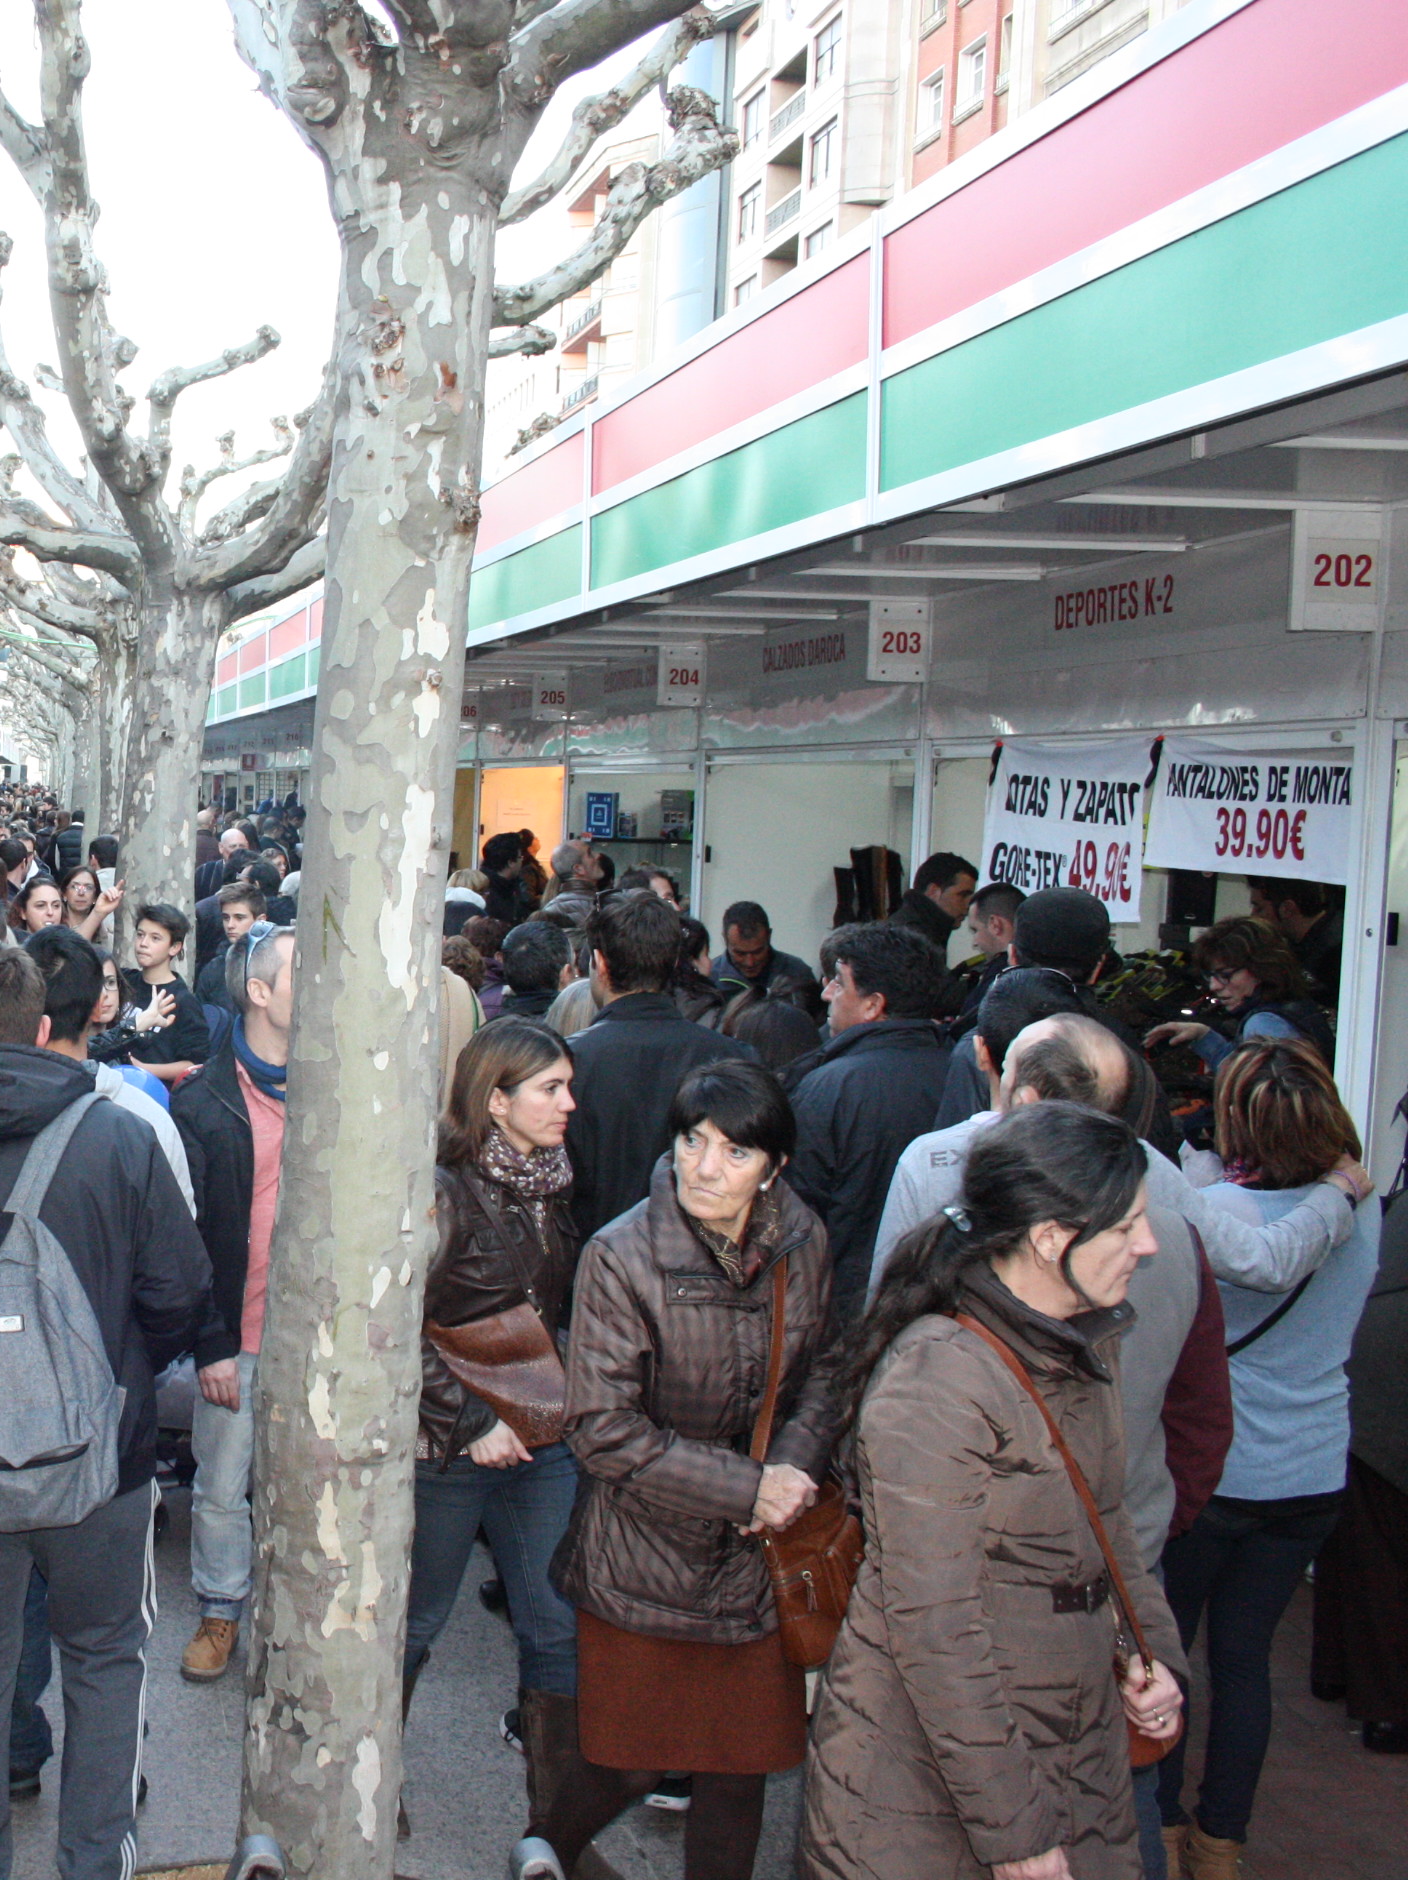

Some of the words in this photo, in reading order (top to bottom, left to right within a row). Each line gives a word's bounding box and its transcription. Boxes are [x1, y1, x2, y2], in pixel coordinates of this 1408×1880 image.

[1313, 553, 1373, 587] 202
[1055, 580, 1139, 631] DEPORTES
[1145, 574, 1174, 616] K-2
[762, 641, 805, 673] CALZADOS
[807, 633, 846, 666] DAROCA
[881, 631, 921, 654] 203
[669, 669, 699, 685] 204
[461, 705, 477, 717] 06
[540, 691, 565, 705] 205
[1060, 778, 1071, 820] Y
[1266, 766, 1289, 803] DE
[1214, 806, 1307, 861] 39.90€
